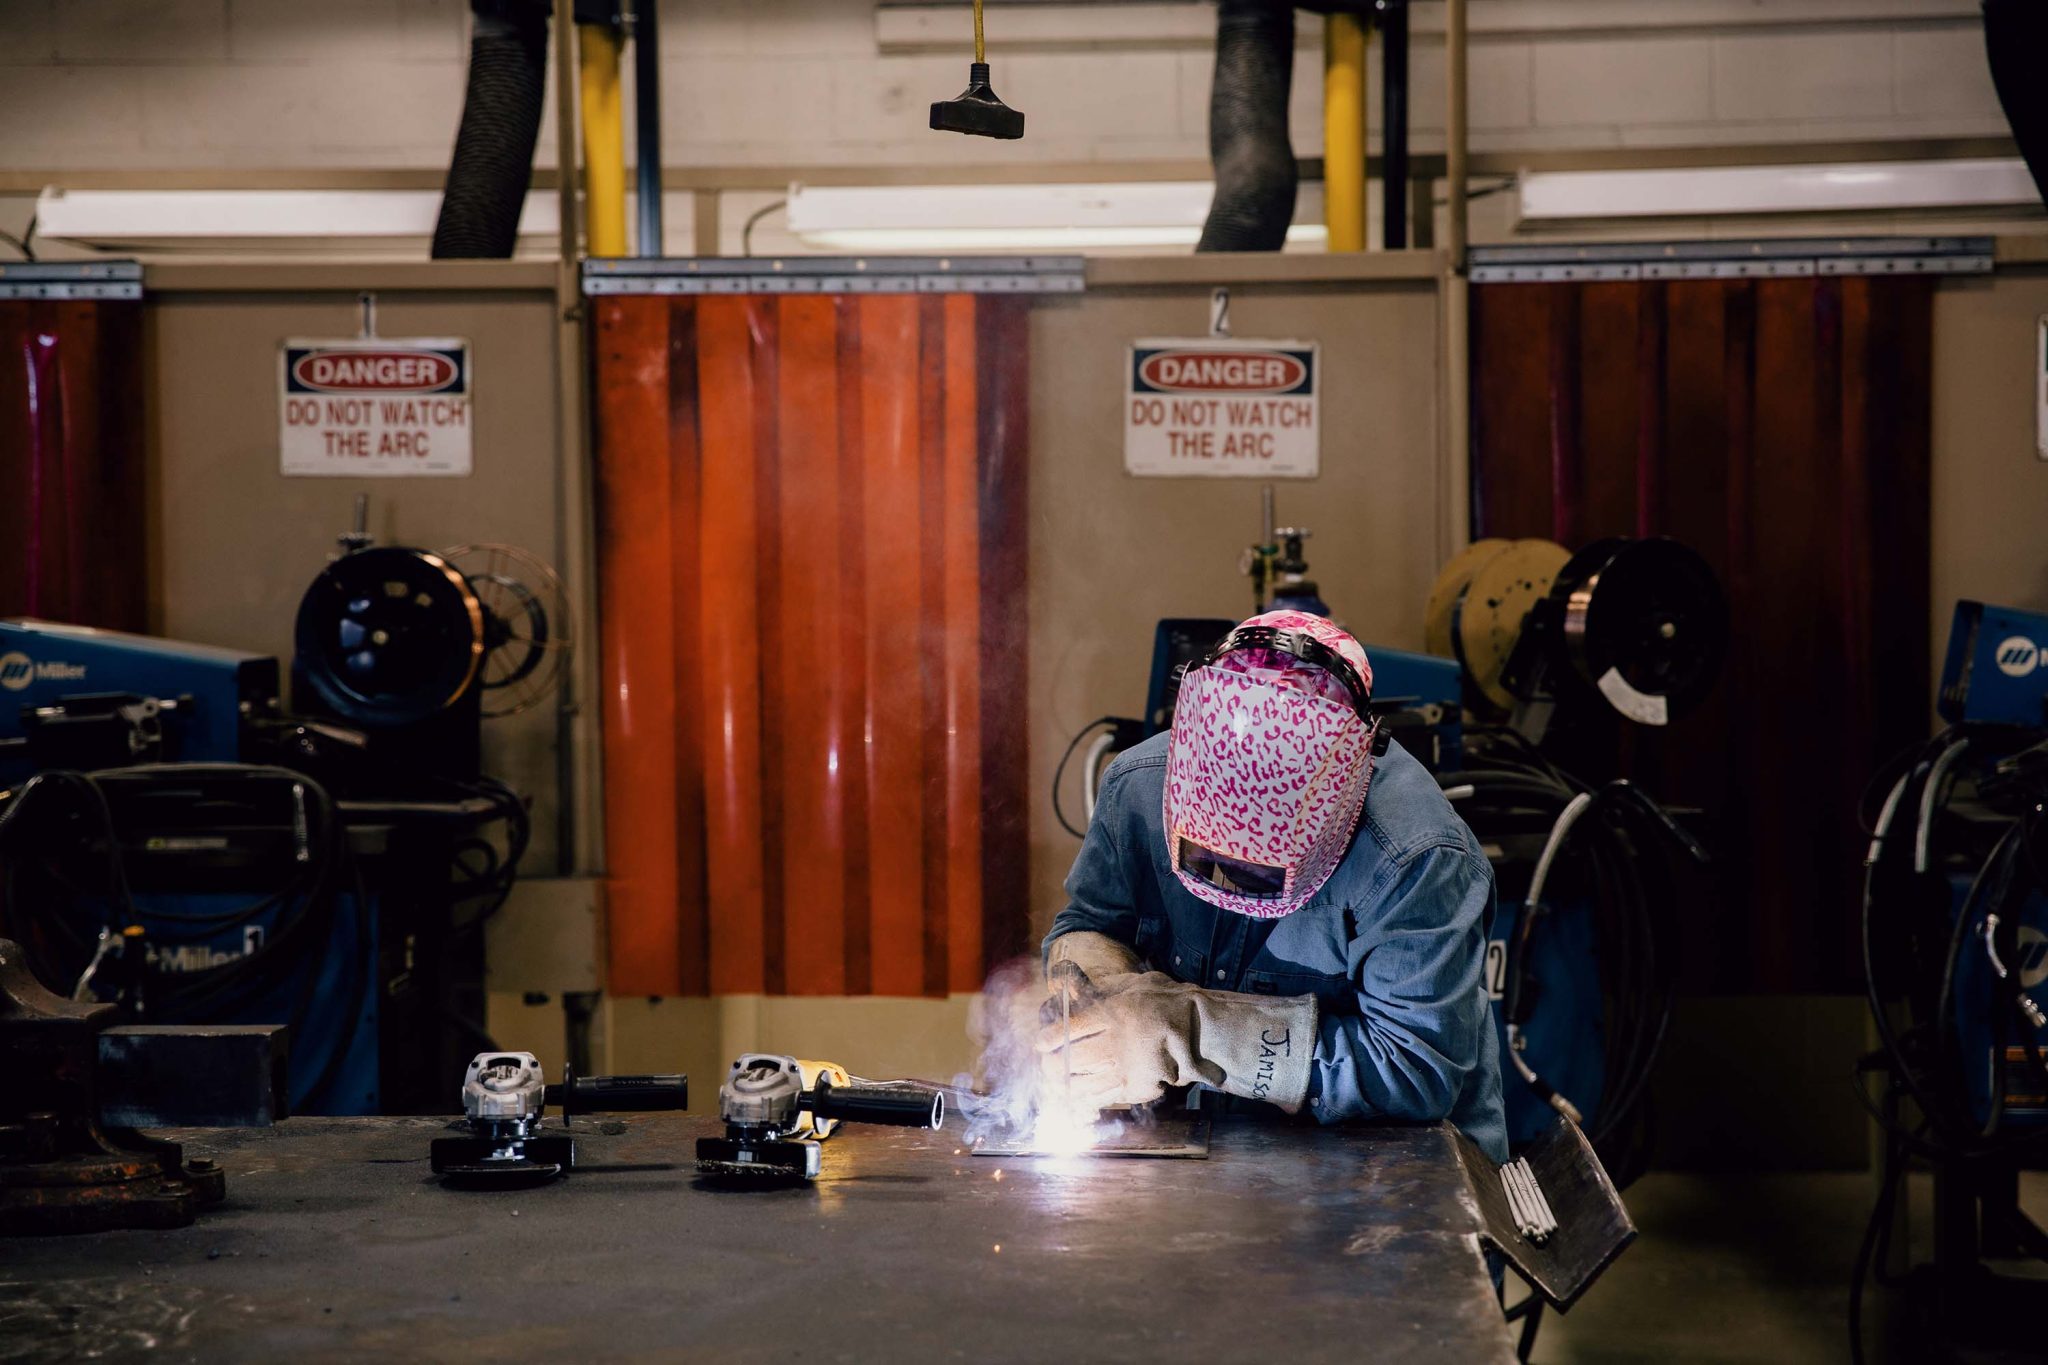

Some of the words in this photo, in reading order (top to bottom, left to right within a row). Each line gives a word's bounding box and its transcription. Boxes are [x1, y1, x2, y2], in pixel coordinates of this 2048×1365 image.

[1215, 289, 1232, 338] 2
[312, 358, 438, 384] DANGER
[1158, 359, 1286, 384] DANGER
[286, 400, 320, 426] DO
[326, 400, 373, 426] NOT
[379, 400, 466, 426] WATCH
[1132, 400, 1165, 426] DO
[1172, 400, 1219, 427] NOT
[1225, 401, 1312, 428] WATCH
[323, 432, 370, 458] THE
[377, 432, 430, 458] ARC
[1166, 431, 1214, 458] THE
[1222, 432, 1274, 459] ARC
[36, 660, 86, 681] Miller
[1490, 945, 1504, 993] 2
